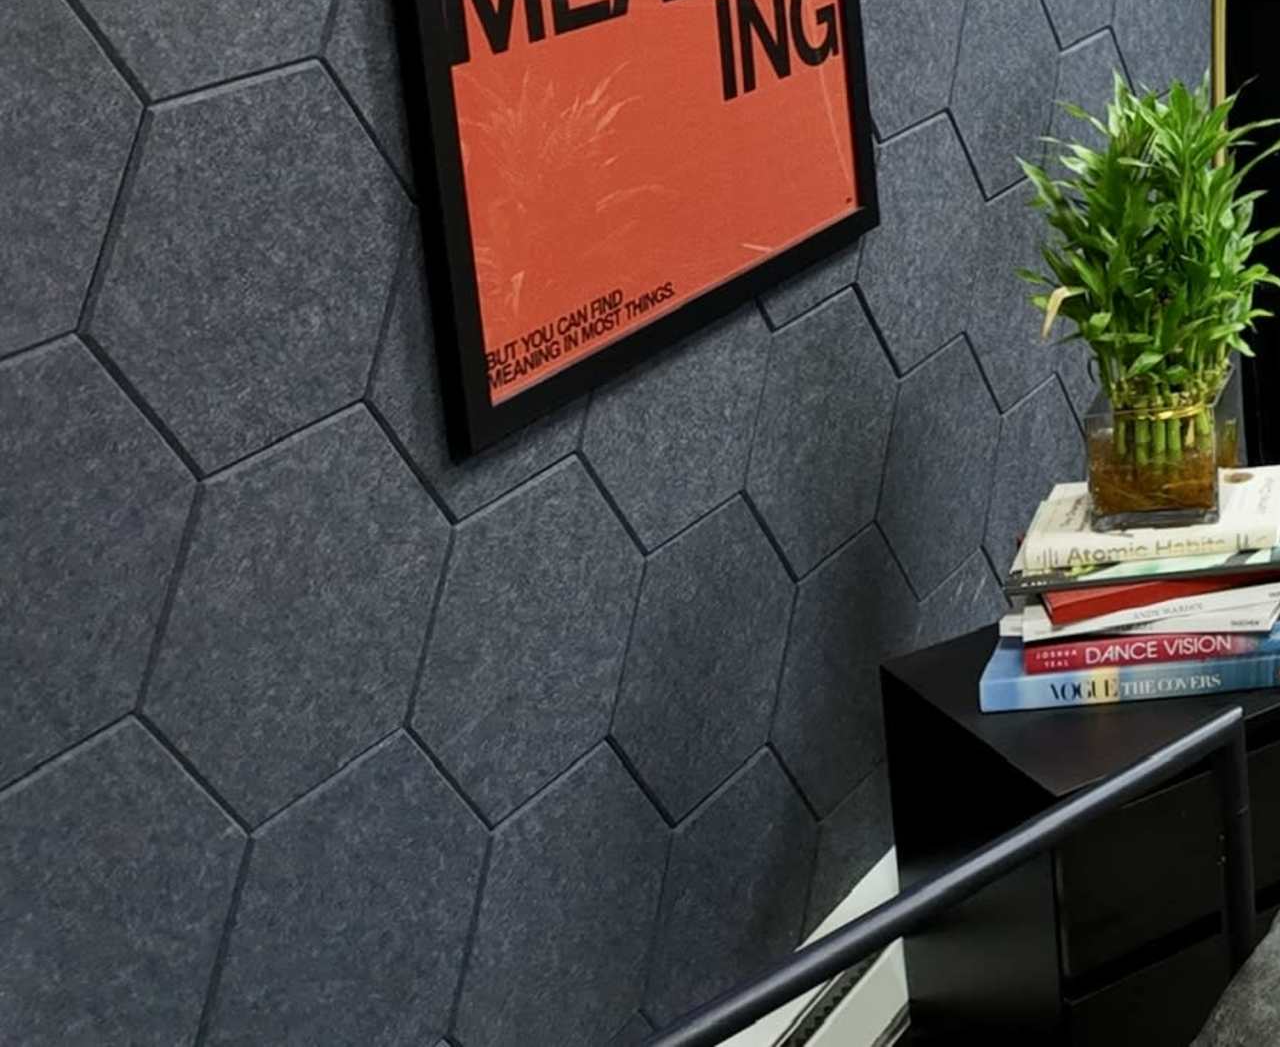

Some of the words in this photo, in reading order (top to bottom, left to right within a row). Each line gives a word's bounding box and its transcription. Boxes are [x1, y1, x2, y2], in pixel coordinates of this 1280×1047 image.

[486, 341, 518, 370] BUT
[521, 323, 555, 351] YOU
[557, 304, 590, 336] CAN
[590, 289, 623, 320] FIND
[487, 341, 561, 388] MEANING
[564, 332, 579, 352] IN
[580, 310, 621, 345] MOST
[1067, 544, 1148, 565] Atomic
[1036, 648, 1079, 661] JOSHUA
[1085, 640, 1159, 665] DANCE
[1163, 635, 1232, 656] VISION
[1050, 680, 1119, 702] VOGUE
[1120, 678, 1157, 697] THE
[1157, 673, 1222, 692] COVERS
